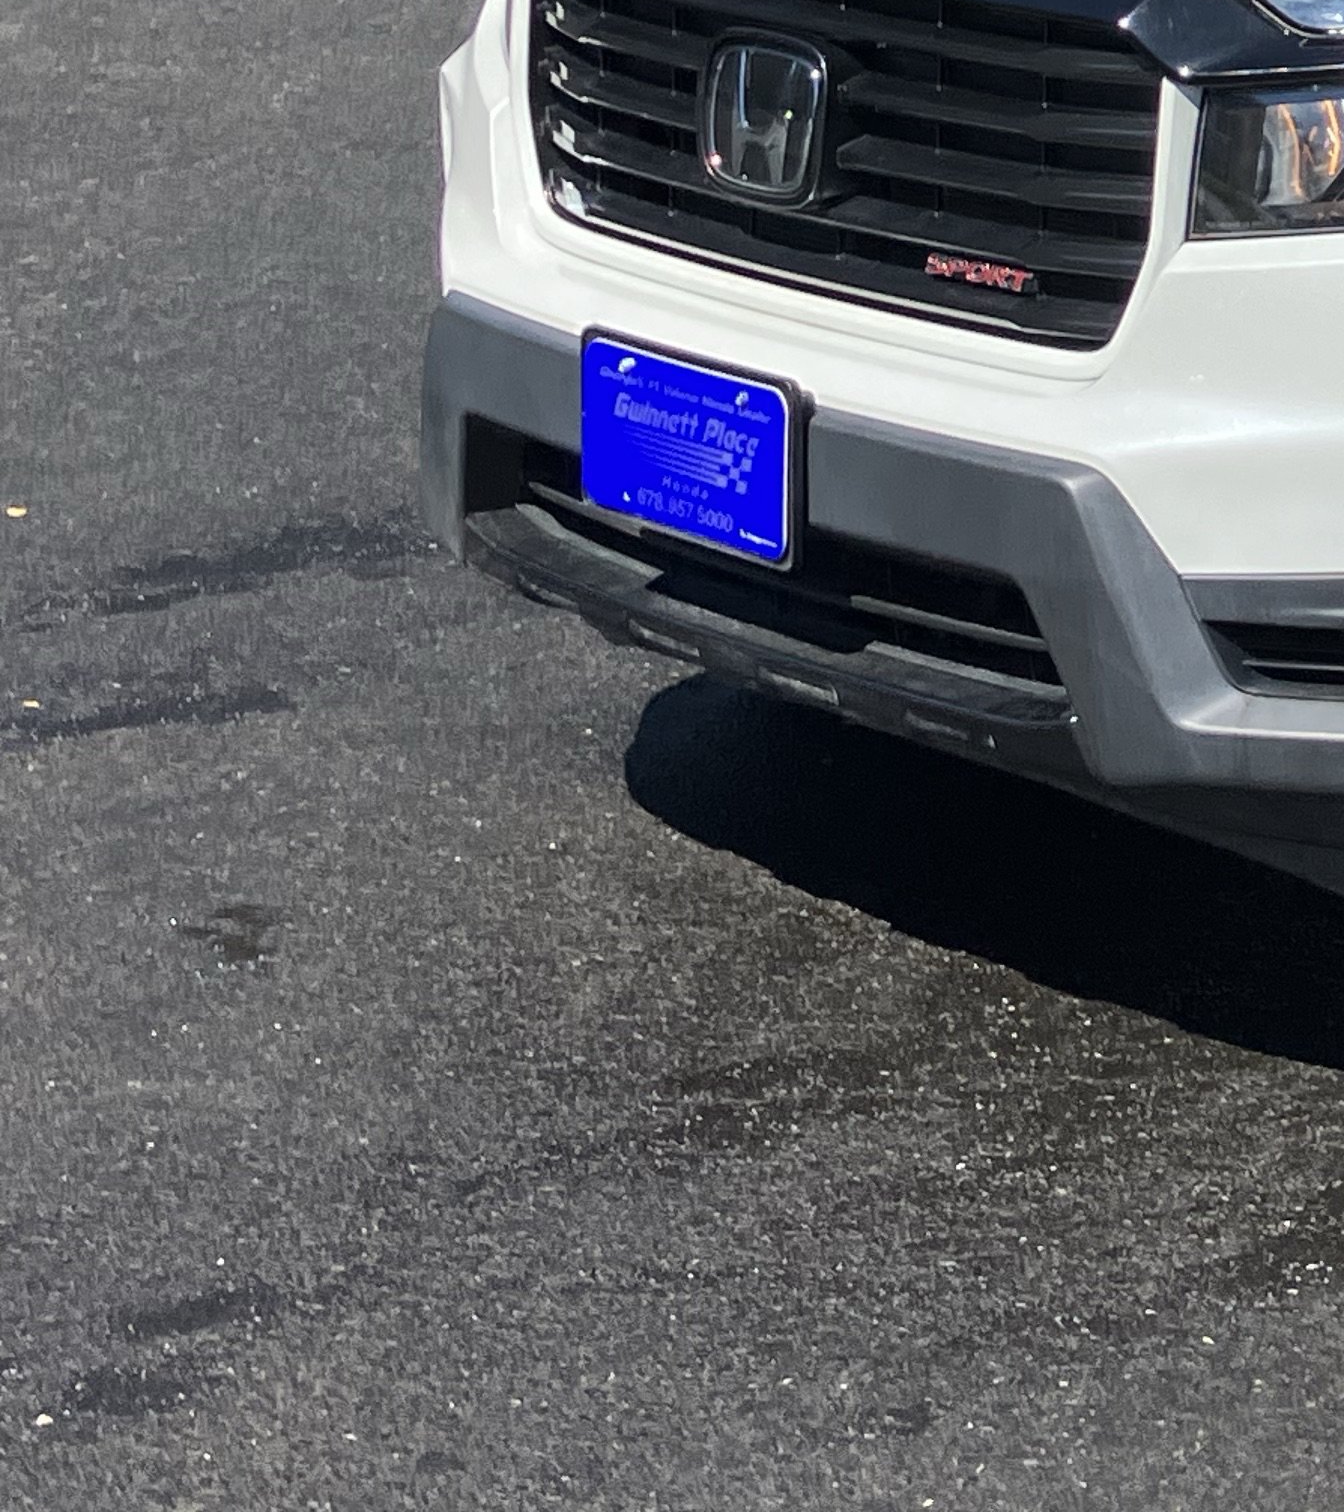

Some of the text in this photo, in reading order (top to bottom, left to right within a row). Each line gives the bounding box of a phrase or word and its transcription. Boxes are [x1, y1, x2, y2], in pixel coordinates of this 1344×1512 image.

[924, 252, 1034, 293] SPORT
[613, 392, 699, 438] Gwinnett
[702, 417, 760, 457] Place
[661, 475, 710, 501] Honda
